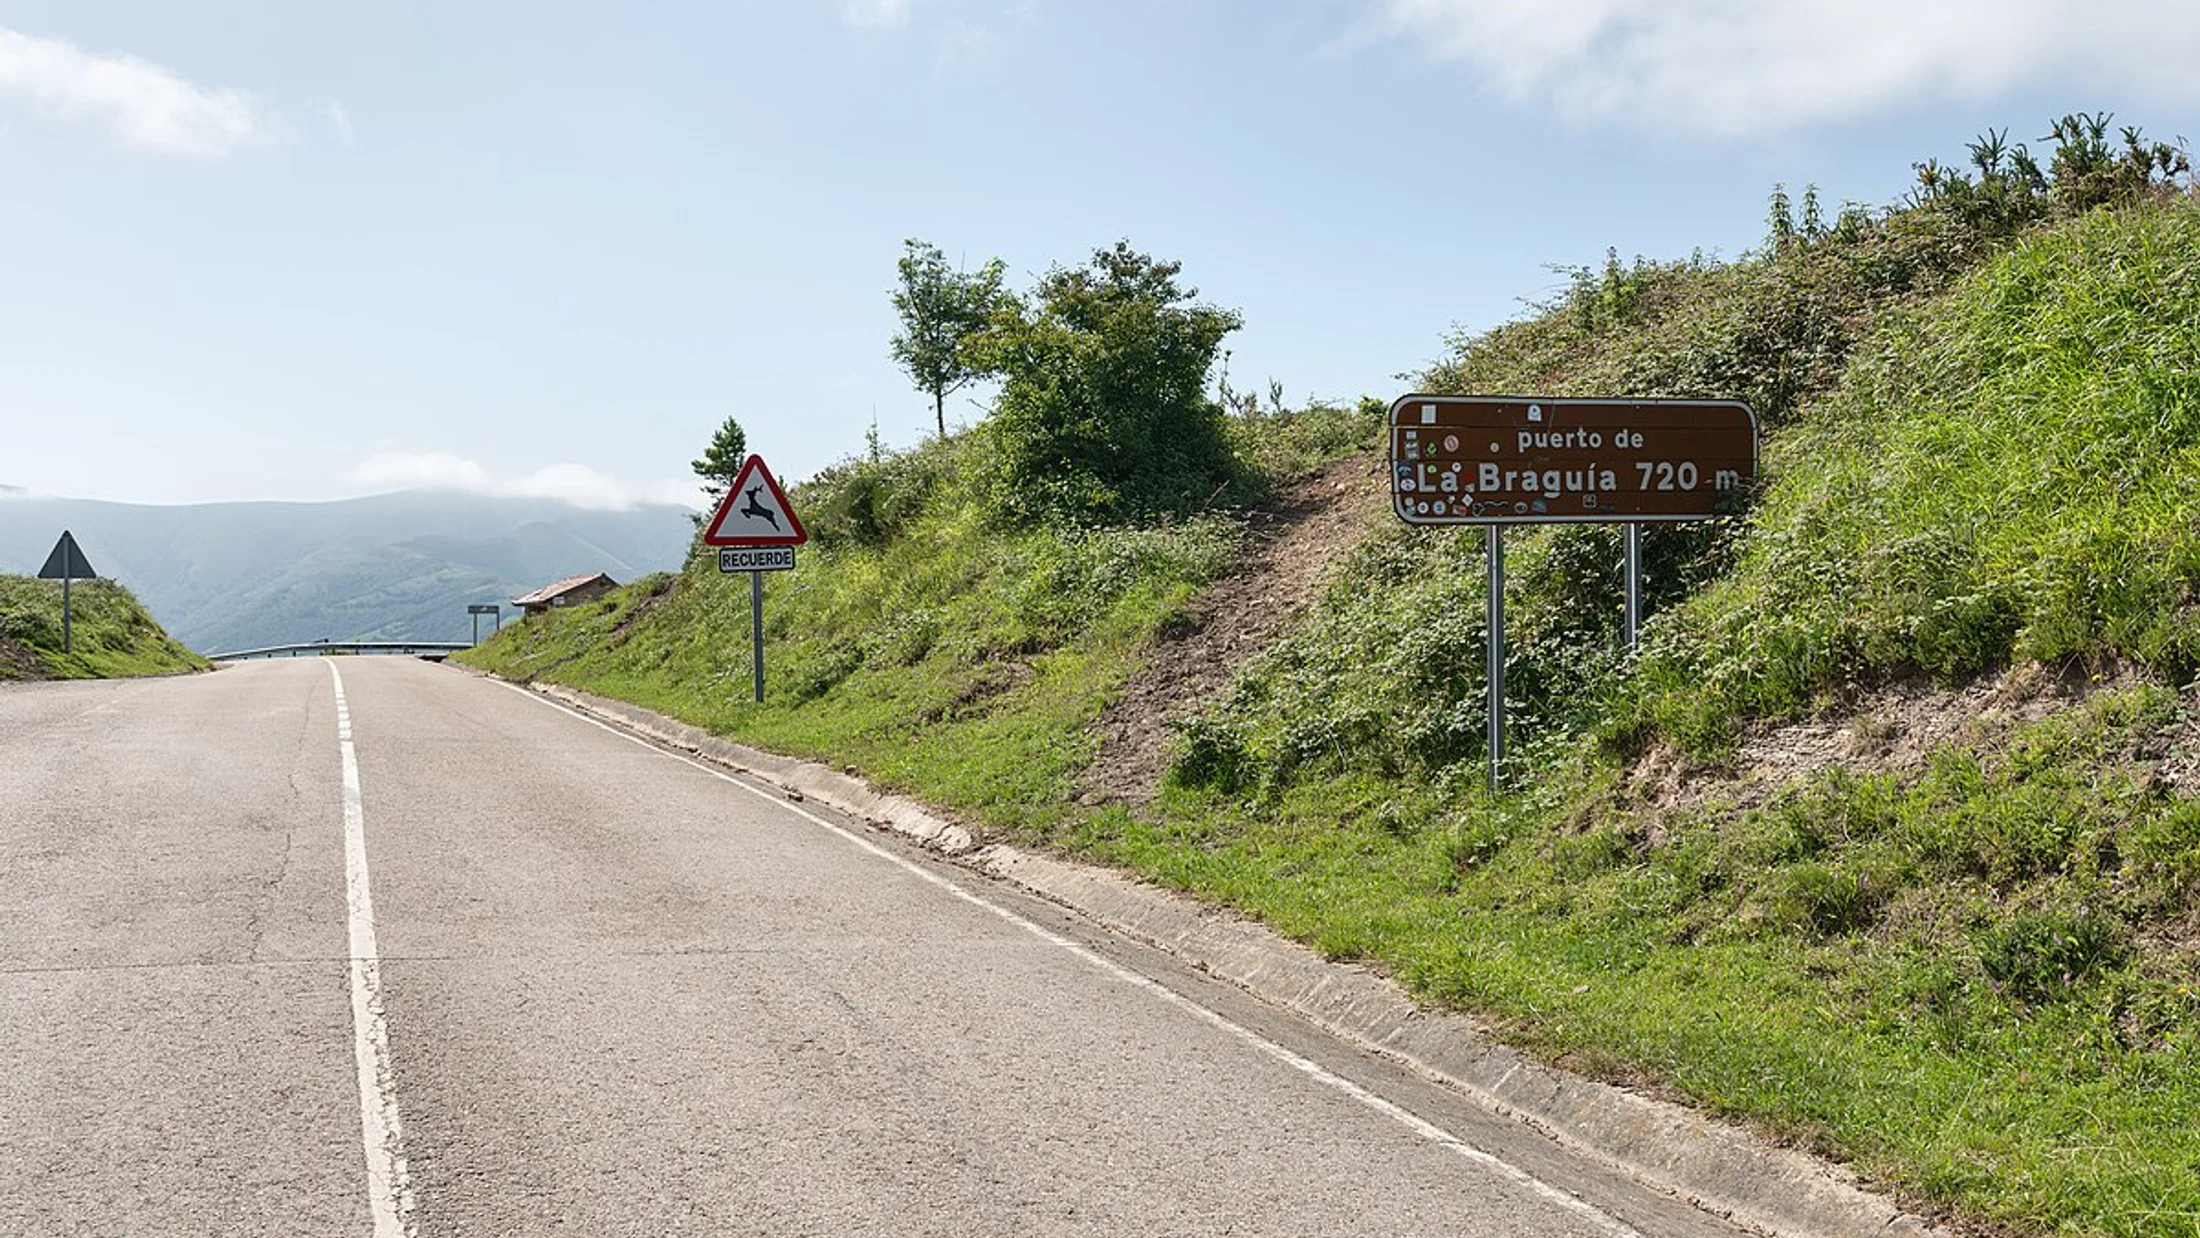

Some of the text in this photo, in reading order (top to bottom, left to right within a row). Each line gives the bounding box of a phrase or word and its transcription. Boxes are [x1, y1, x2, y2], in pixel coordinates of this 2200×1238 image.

[1517, 427, 1644, 452] puerto de
[1417, 462, 1739, 498] La Braguía 720 m
[722, 552, 791, 567] RECUERDE
